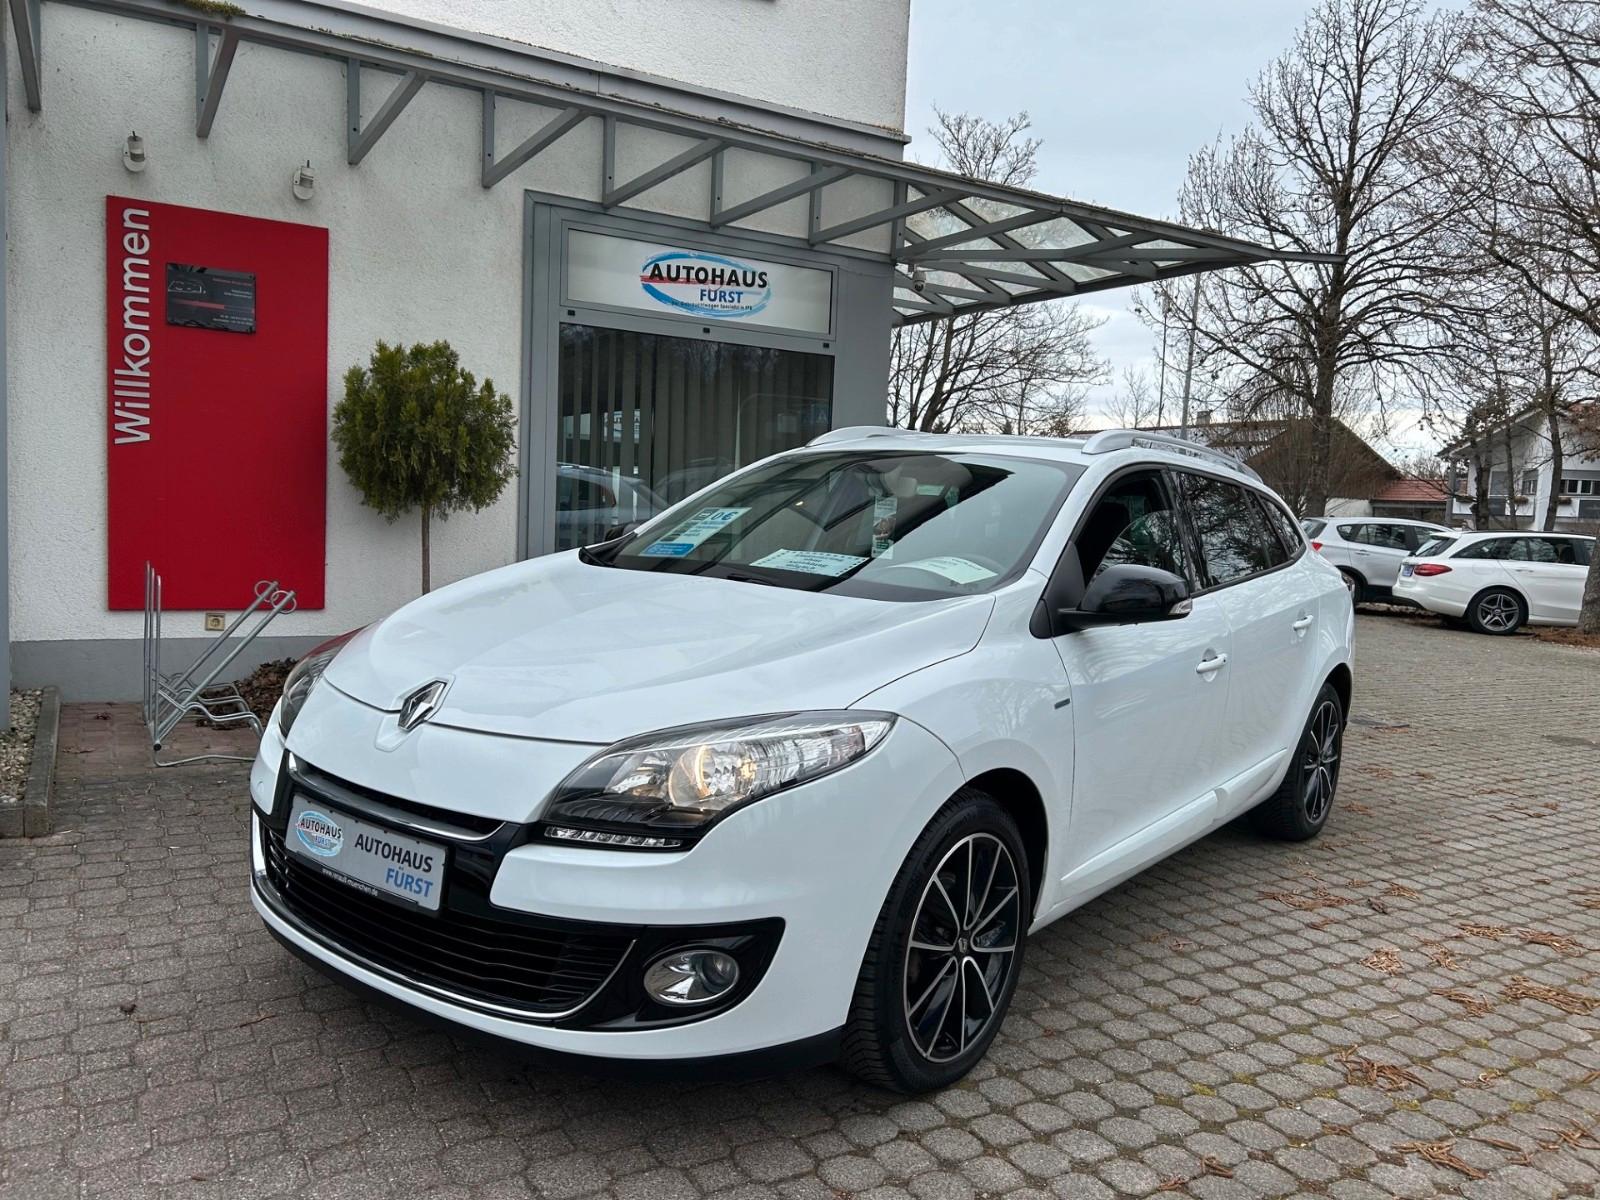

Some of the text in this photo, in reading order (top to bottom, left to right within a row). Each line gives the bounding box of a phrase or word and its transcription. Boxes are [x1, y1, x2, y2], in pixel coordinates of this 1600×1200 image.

[649, 263, 768, 289] AUTOHAUS
[114, 207, 150, 445] Willkommen
[300, 818, 342, 839] AUTOHAUS
[354, 833, 433, 873] AUTOHAUS
[385, 866, 434, 898] FÜRST
